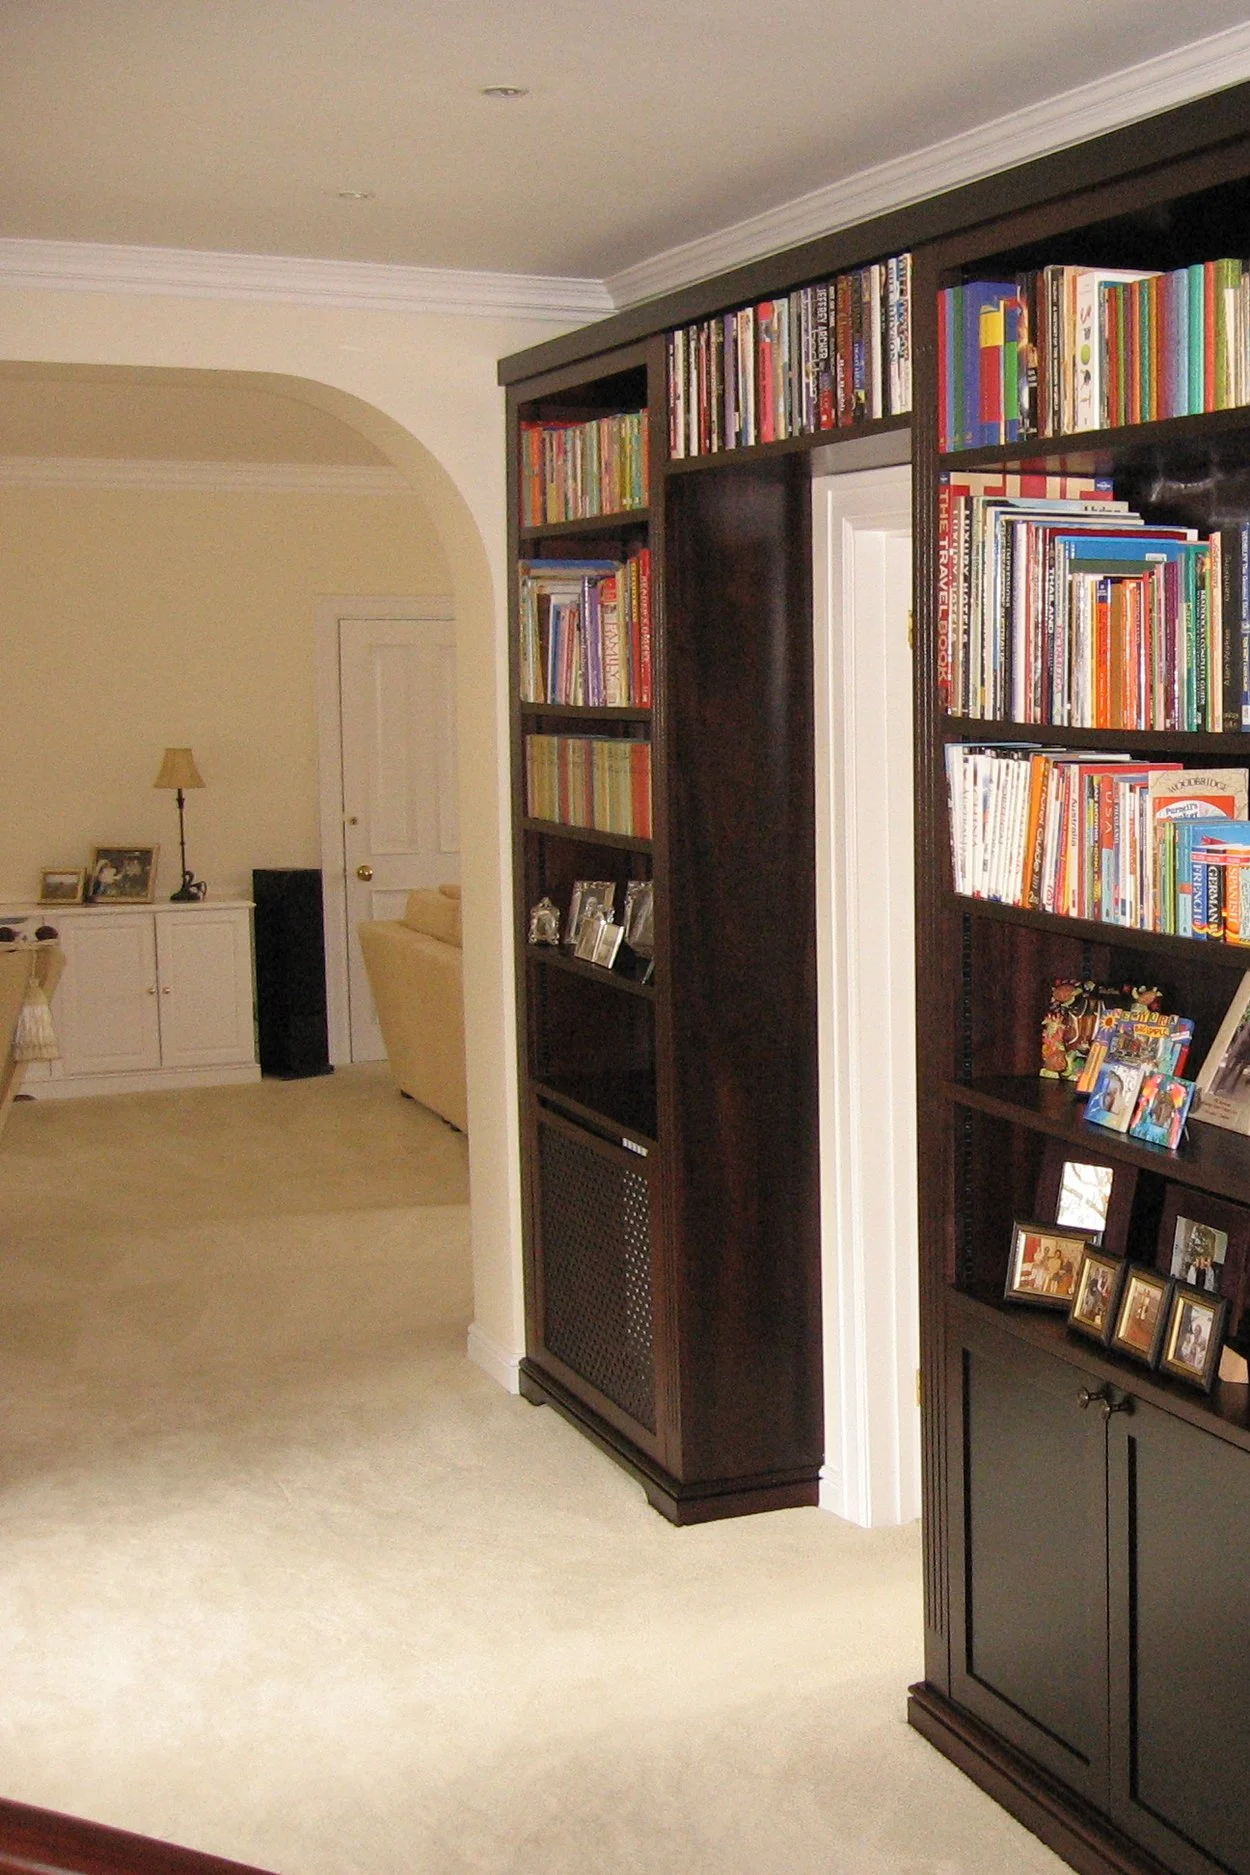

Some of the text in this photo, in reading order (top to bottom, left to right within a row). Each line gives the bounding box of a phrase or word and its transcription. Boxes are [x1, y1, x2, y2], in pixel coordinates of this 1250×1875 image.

[816, 288, 829, 324] JEFFREY
[888, 304, 899, 360] BRYSON
[896, 299, 909, 360] BRYSON
[816, 325, 829, 360] ARCHER
[938, 488, 951, 682] THE TRAVEL BOOK
[961, 509, 971, 645] LUXURY HOTELS
[1047, 567, 1057, 634] THAILAND
[604, 622, 620, 681] FAMILY
[1105, 790, 1114, 835] USA
[1167, 776, 1228, 793] WOODBRIDGE
[1032, 827, 1045, 873] Guide
[1071, 797, 1080, 848] Australia
[1192, 861, 1204, 925] FRENCH
[1208, 865, 1220, 934] GERMAN
[1228, 865, 1241, 924] SPANISH
